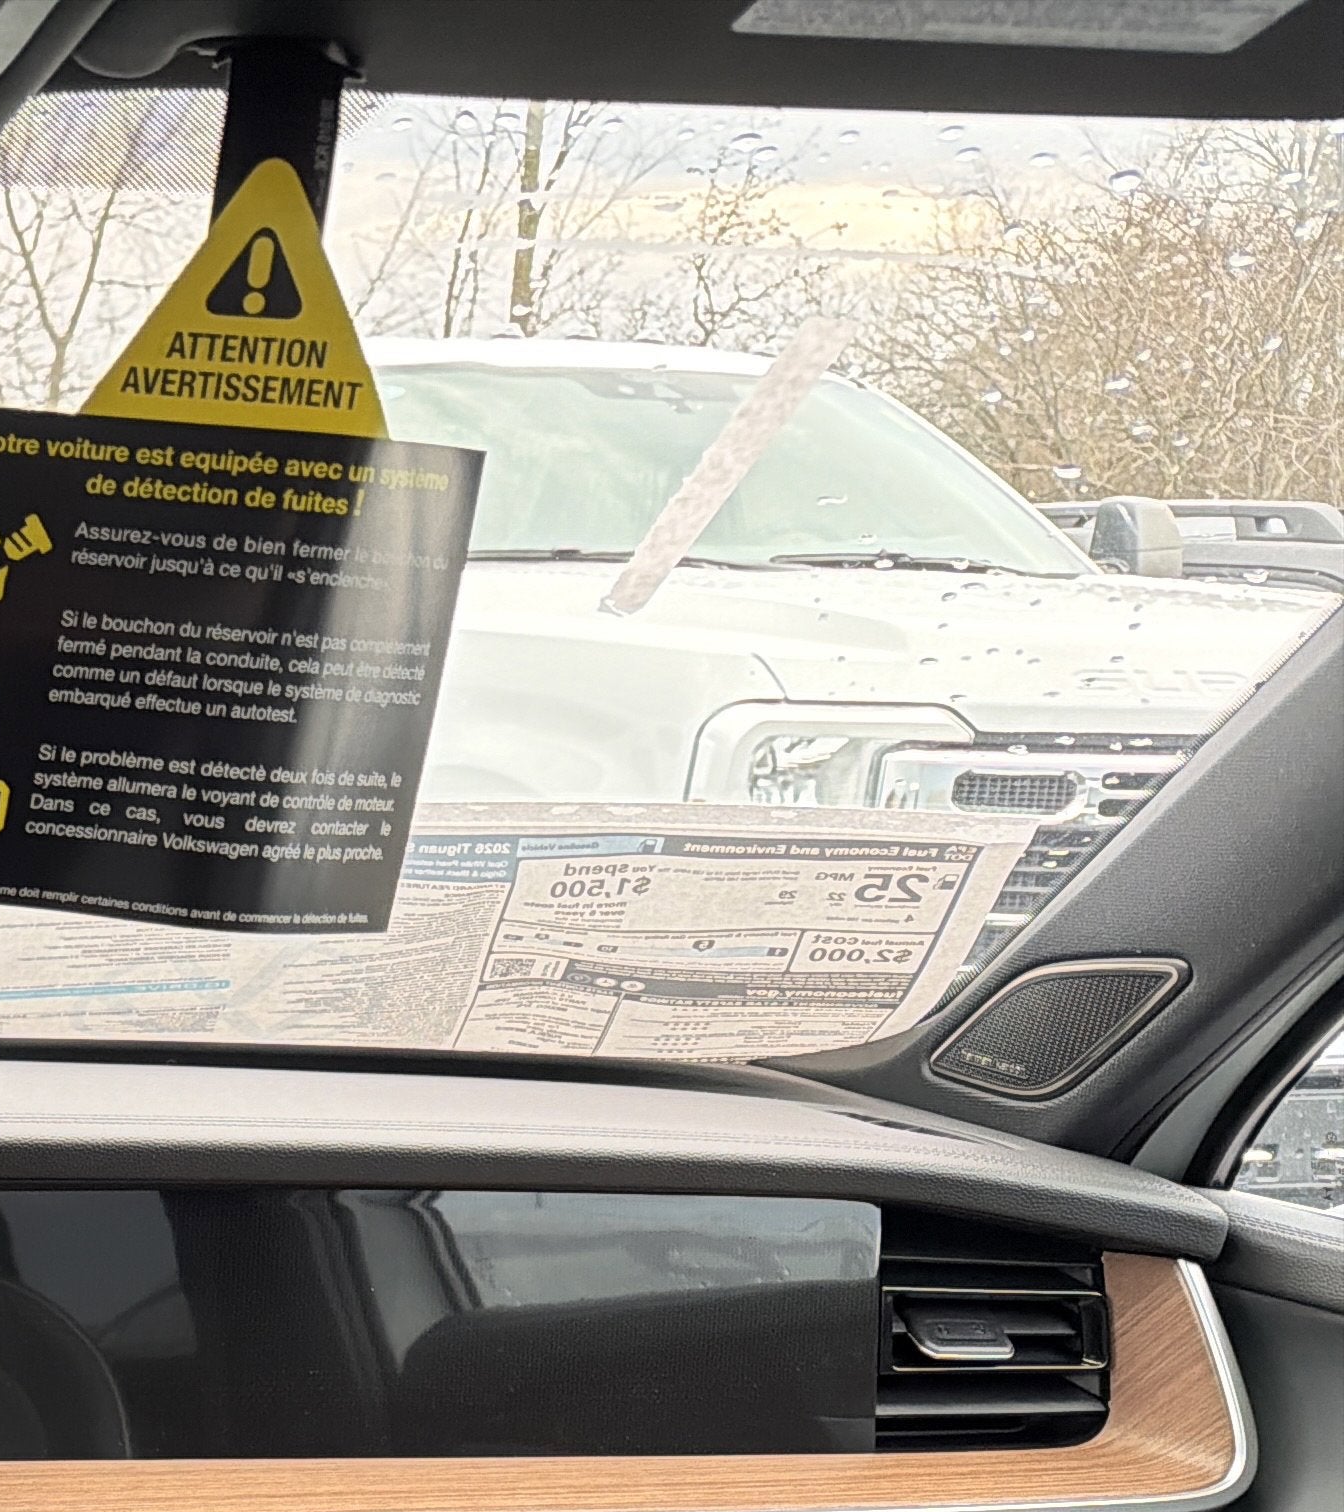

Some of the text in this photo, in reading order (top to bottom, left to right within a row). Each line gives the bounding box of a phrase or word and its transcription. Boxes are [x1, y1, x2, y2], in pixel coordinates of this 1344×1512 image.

[166, 331, 327, 369] ATTENTION
[121, 367, 363, 410] AVERTISSEMENT
[46, 438, 130, 464] voiture
[136, 445, 174, 467] est
[179, 445, 279, 478] equipée
[284, 458, 343, 481] avec
[349, 463, 375, 484] un
[86, 473, 365, 517] de détection de fuites !
[74, 521, 351, 561] Assurez-vous de bien fermer
[71, 546, 282, 584] réservoir jusqu'à ce qu'il
[60, 609, 78, 626] Si
[82, 612, 97, 628] le
[101, 613, 174, 636] bouchon
[179, 621, 201, 638] du
[205, 622, 275, 645] réservoir
[280, 629, 319, 649] n'est
[320, 636, 347, 655] pas
[56, 634, 105, 656] fermé
[110, 640, 181, 665] pendant
[186, 648, 201, 663] la
[205, 649, 283, 674] conduite,
[288, 656, 319, 674] cela
[322, 660, 353, 681] peut
[49, 684, 297, 723] embarqué effectue un autotest.
[52, 662, 113, 683] comme
[118, 668, 139, 684] un
[144, 668, 197, 689] défaut
[201, 673, 262, 700] lorsque
[267, 679, 280, 696] le
[284, 680, 342, 706] système
[345, 686, 361, 701] de
[33, 768, 102, 793] système
[107, 776, 177, 799] allumera
[181, 782, 196, 799] le
[200, 785, 255, 810] voyant
[259, 789, 279, 807] de
[282, 790, 334, 811] contrôle
[337, 795, 353, 810] de
[38, 745, 55, 761] Si
[60, 747, 75, 763] le
[79, 747, 163, 773] problème
[168, 758, 194, 774] est
[270, 765, 306, 783] deux
[311, 768, 334, 785] fois
[338, 769, 354, 786] de
[356, 770, 387, 790] suite,
[390, 772, 401, 788] le
[30, 793, 392, 839] Dans ce cas, vous devrez contacter le
[25, 819, 383, 866] concessionnaire Volkswagen agréé le plus proche.
[18, 885, 39, 900] doit
[41, 888, 78, 905] remplir
[81, 893, 129, 910] certaines
[132, 898, 187, 917] conditions
[190, 907, 220, 920] avant
[223, 908, 236, 922] de
